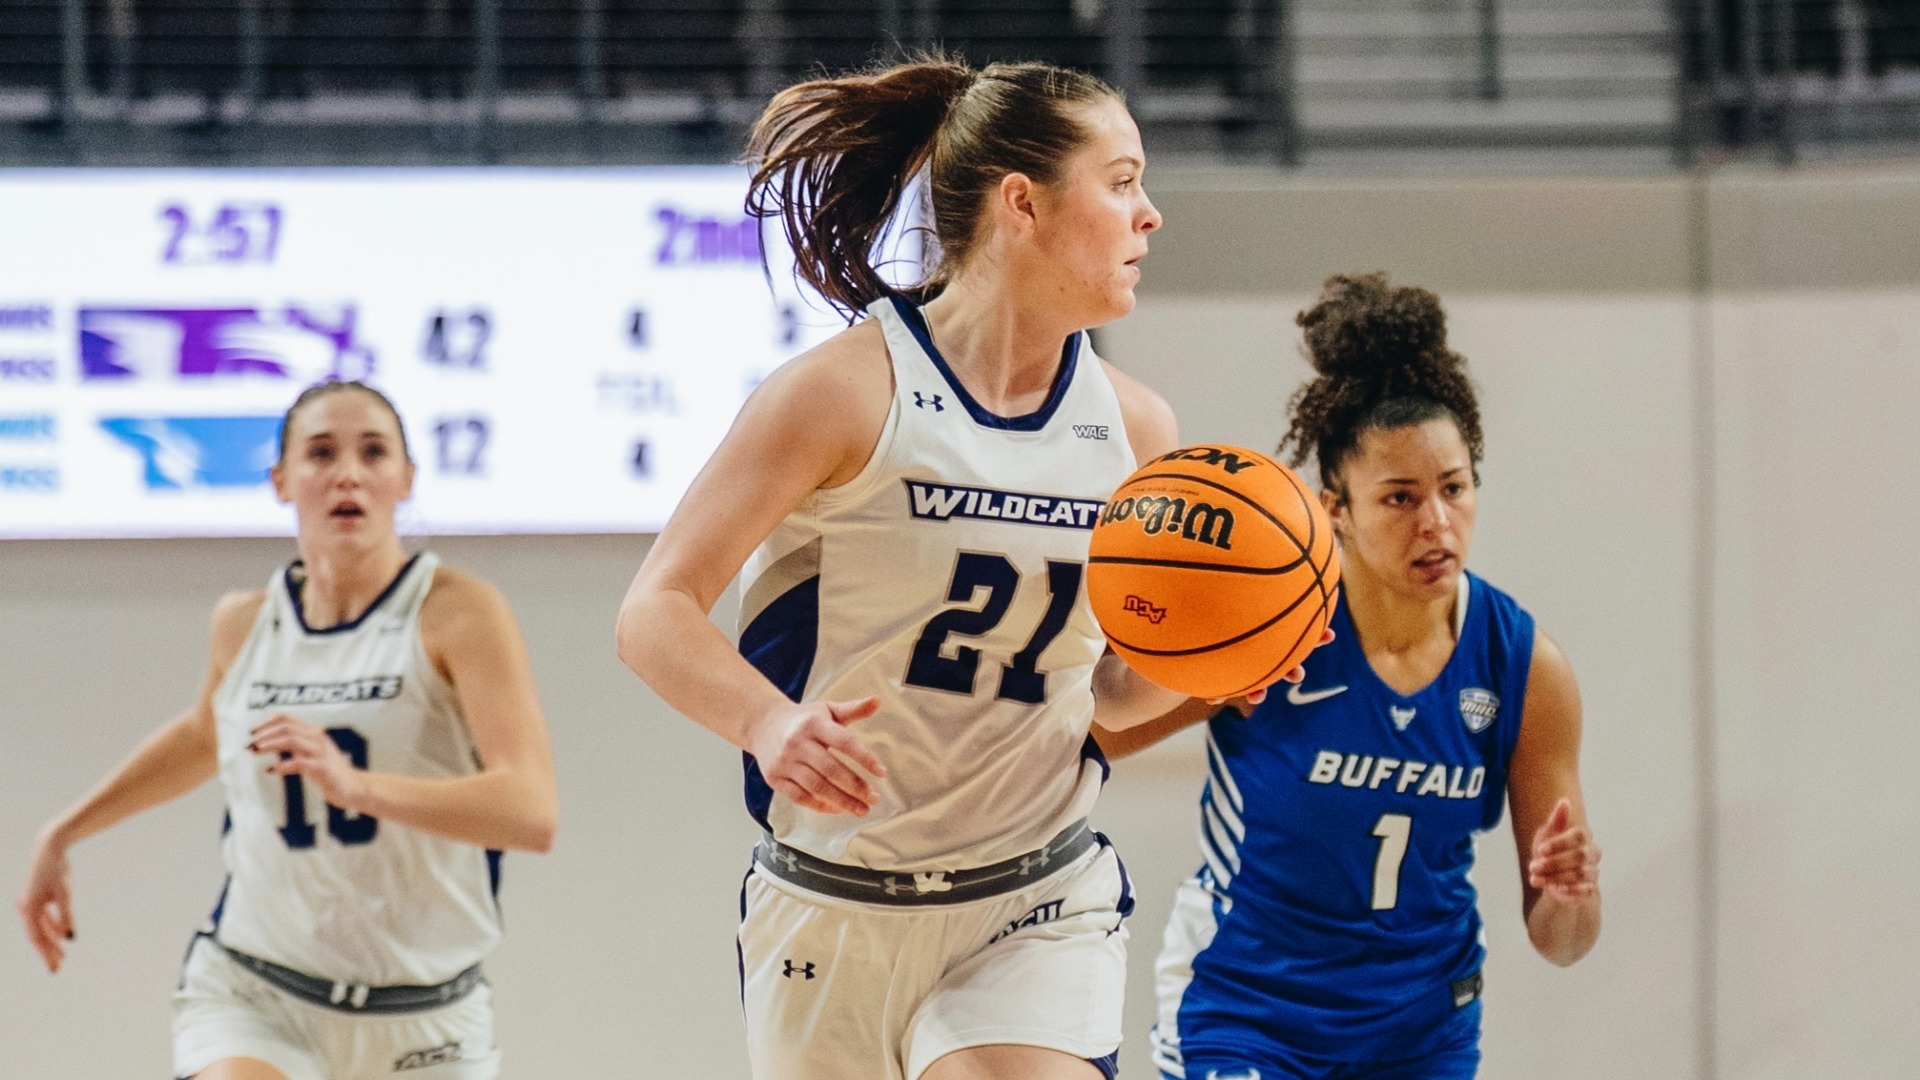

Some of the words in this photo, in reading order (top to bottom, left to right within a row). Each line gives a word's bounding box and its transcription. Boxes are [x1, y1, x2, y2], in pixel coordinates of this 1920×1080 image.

[157, 202, 284, 266] 2:57
[422, 306, 494, 370] 42
[432, 415, 493, 475] 12
[1072, 425, 1109, 440] WAC
[1100, 496, 1235, 550] Wilson
[903, 549, 1085, 705] 21
[1123, 594, 1167, 624] ACU
[249, 676, 403, 709] WILDCATS
[1308, 750, 1486, 799] BUFFALO
[1371, 813, 1412, 911] 1
